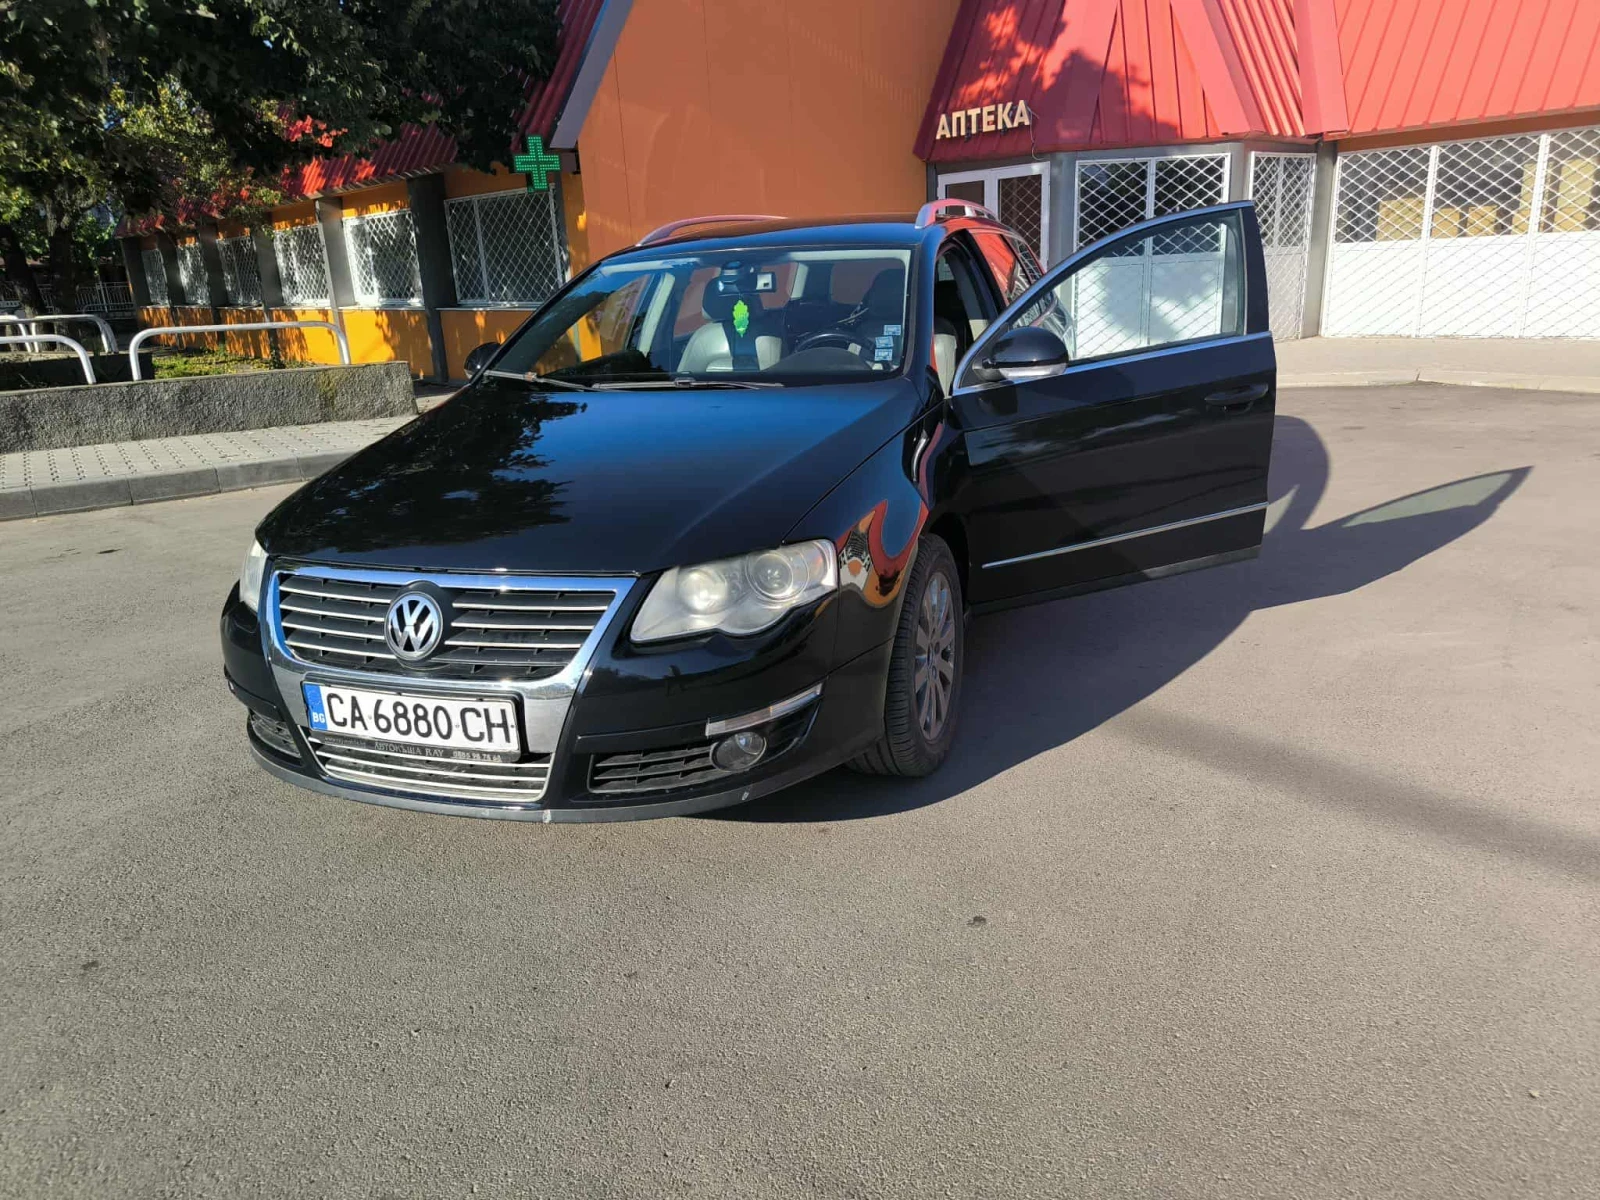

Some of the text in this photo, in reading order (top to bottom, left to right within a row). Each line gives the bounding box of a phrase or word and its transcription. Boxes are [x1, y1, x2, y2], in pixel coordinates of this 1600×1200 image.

[935, 99, 1031, 140] АПТЕКА
[312, 711, 326, 724] BG
[326, 692, 512, 744] CA 6880 CH
